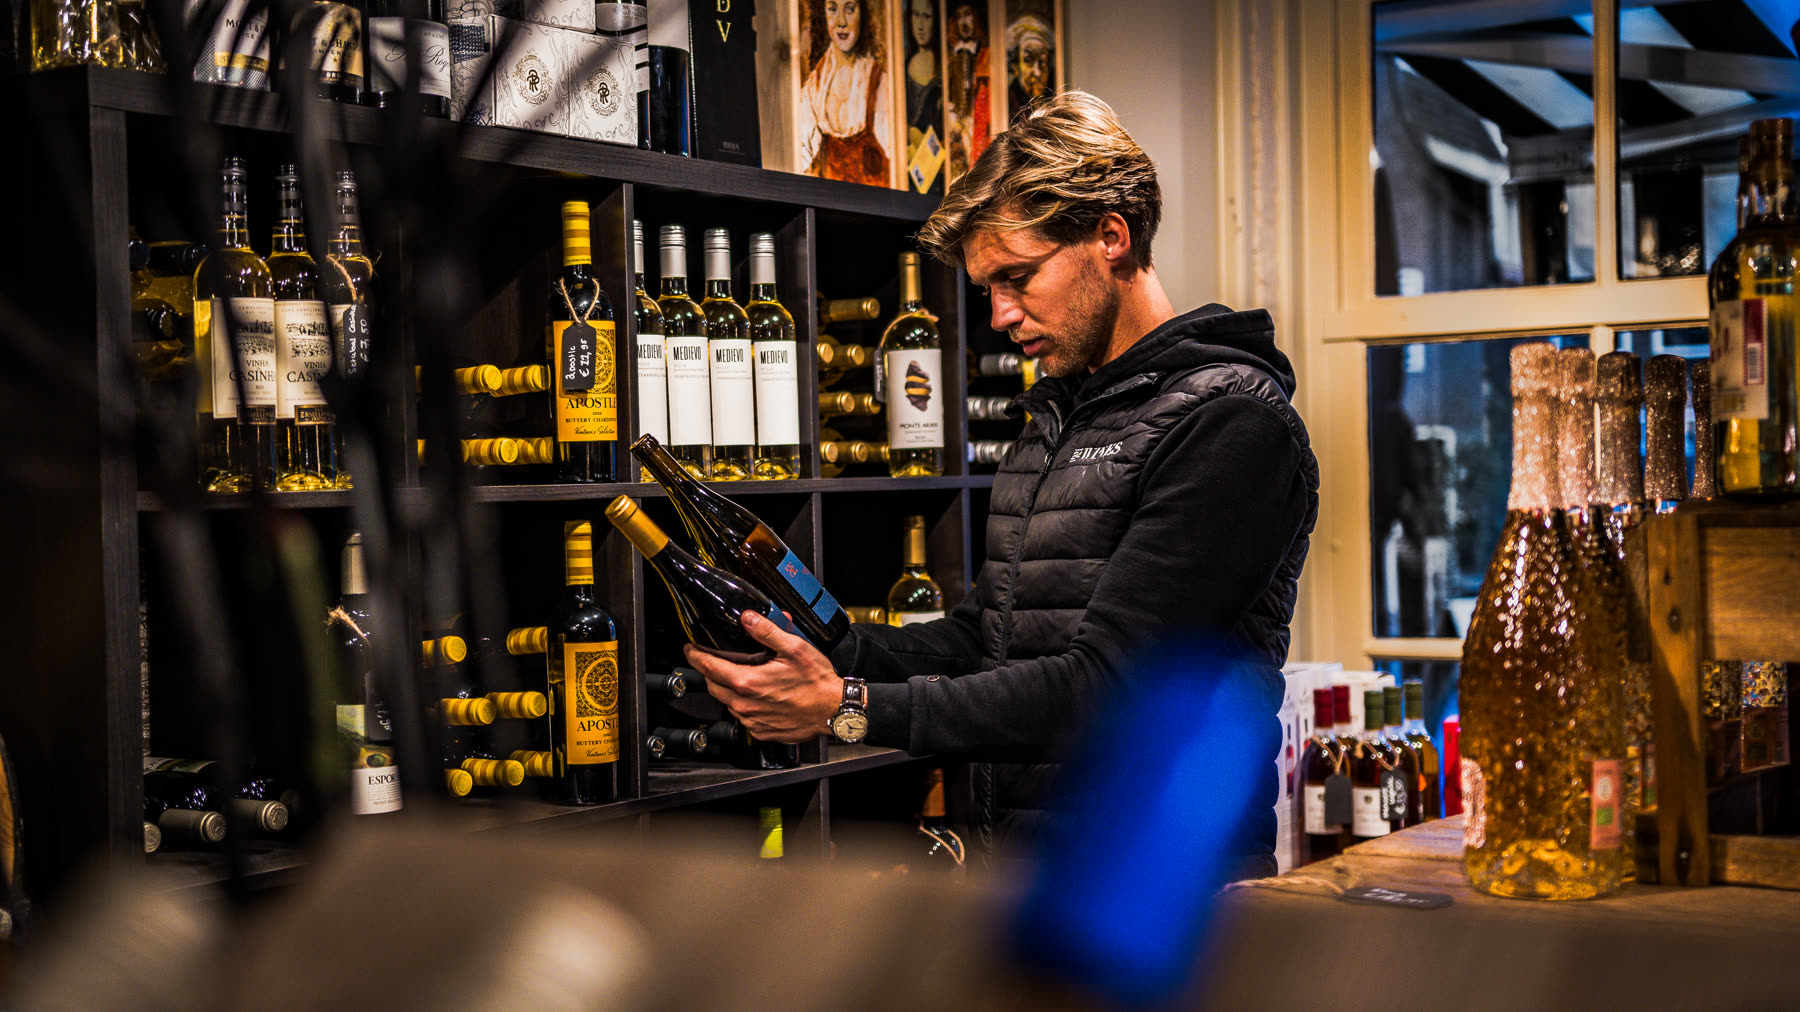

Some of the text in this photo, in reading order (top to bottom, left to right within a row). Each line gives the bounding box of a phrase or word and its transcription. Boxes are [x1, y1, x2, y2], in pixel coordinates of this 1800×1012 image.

[425, 44, 449, 72] Rog
[673, 346, 702, 361] MEDIEVO
[715, 348, 744, 363] MEDIEVO
[760, 350, 788, 364] MEDIEVO
[246, 359, 269, 367] VINHA
[304, 361, 327, 369] VINHA
[229, 369, 274, 382] CASINH
[576, 718, 617, 731] APOST
[368, 773, 398, 785] ESPOR
